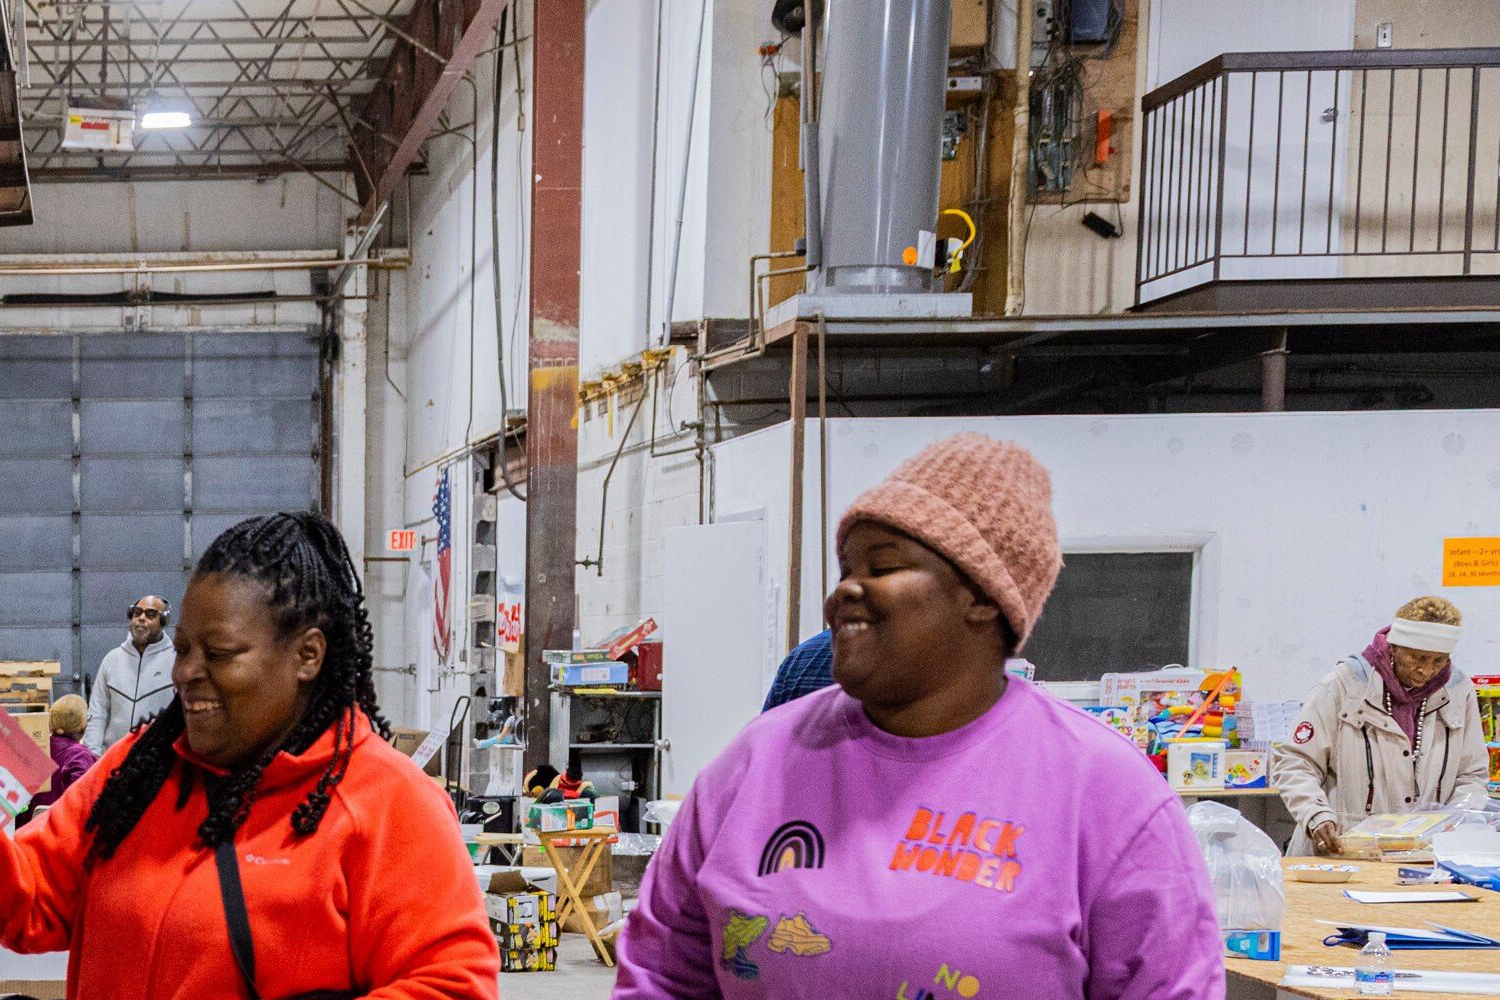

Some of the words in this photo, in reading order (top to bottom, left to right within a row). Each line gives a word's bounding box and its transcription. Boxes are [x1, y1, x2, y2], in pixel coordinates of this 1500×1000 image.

[391, 531, 415, 549] EXIT
[904, 806, 1025, 860] BLACK
[887, 839, 1023, 893] WONDER
[934, 963, 981, 998] NO
